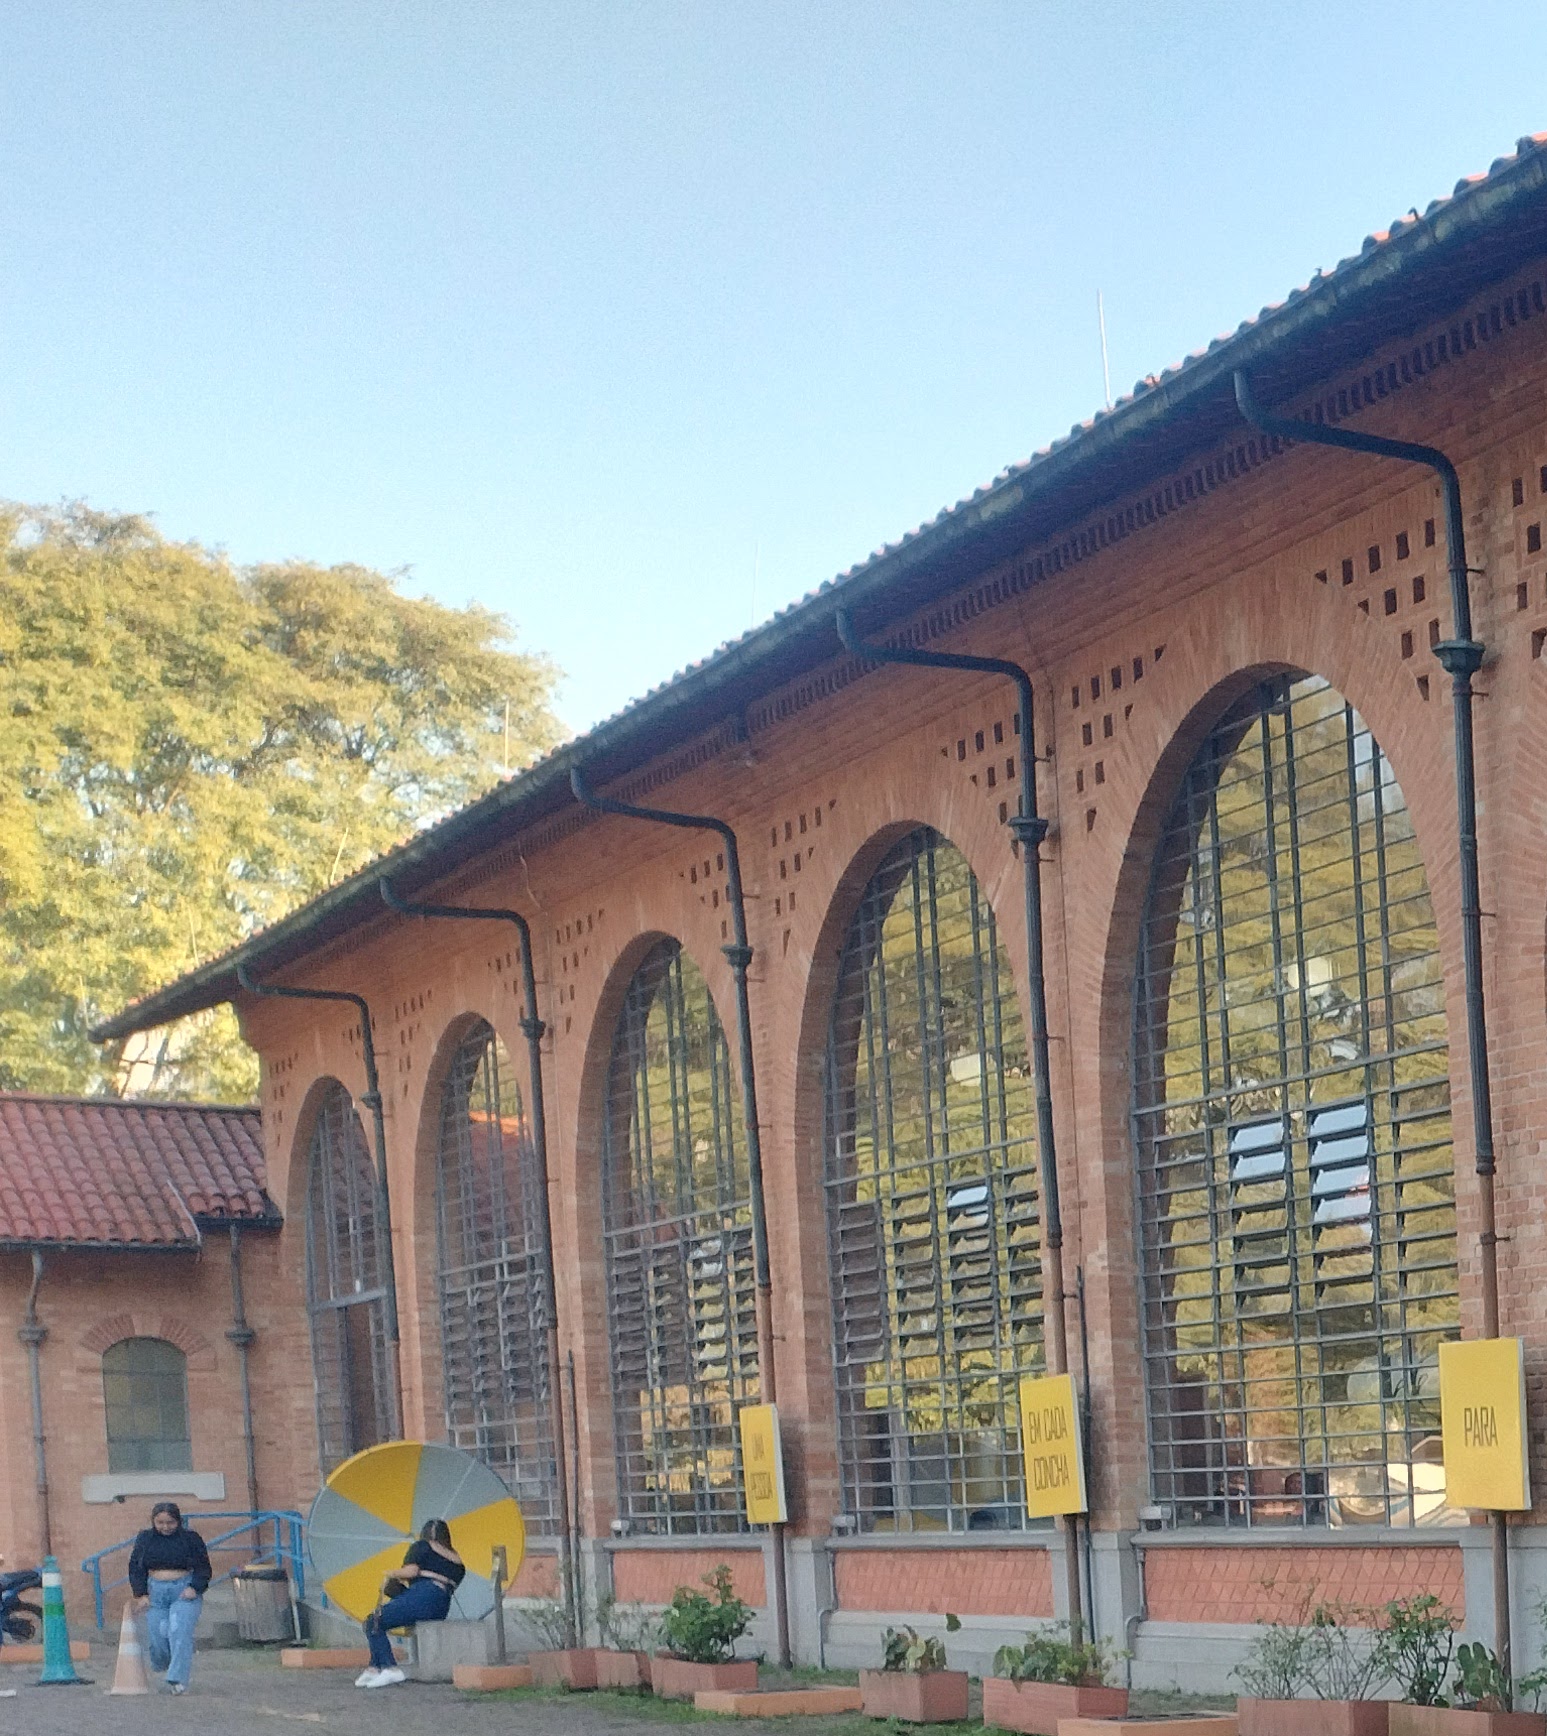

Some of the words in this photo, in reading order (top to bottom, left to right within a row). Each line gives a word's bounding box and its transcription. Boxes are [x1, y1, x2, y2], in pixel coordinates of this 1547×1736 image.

[1028, 1411, 1042, 1445] EM
[1043, 1405, 1068, 1442] CADA
[1463, 1405, 1499, 1447] PARA
[1033, 1454, 1070, 1491] CONCHA
